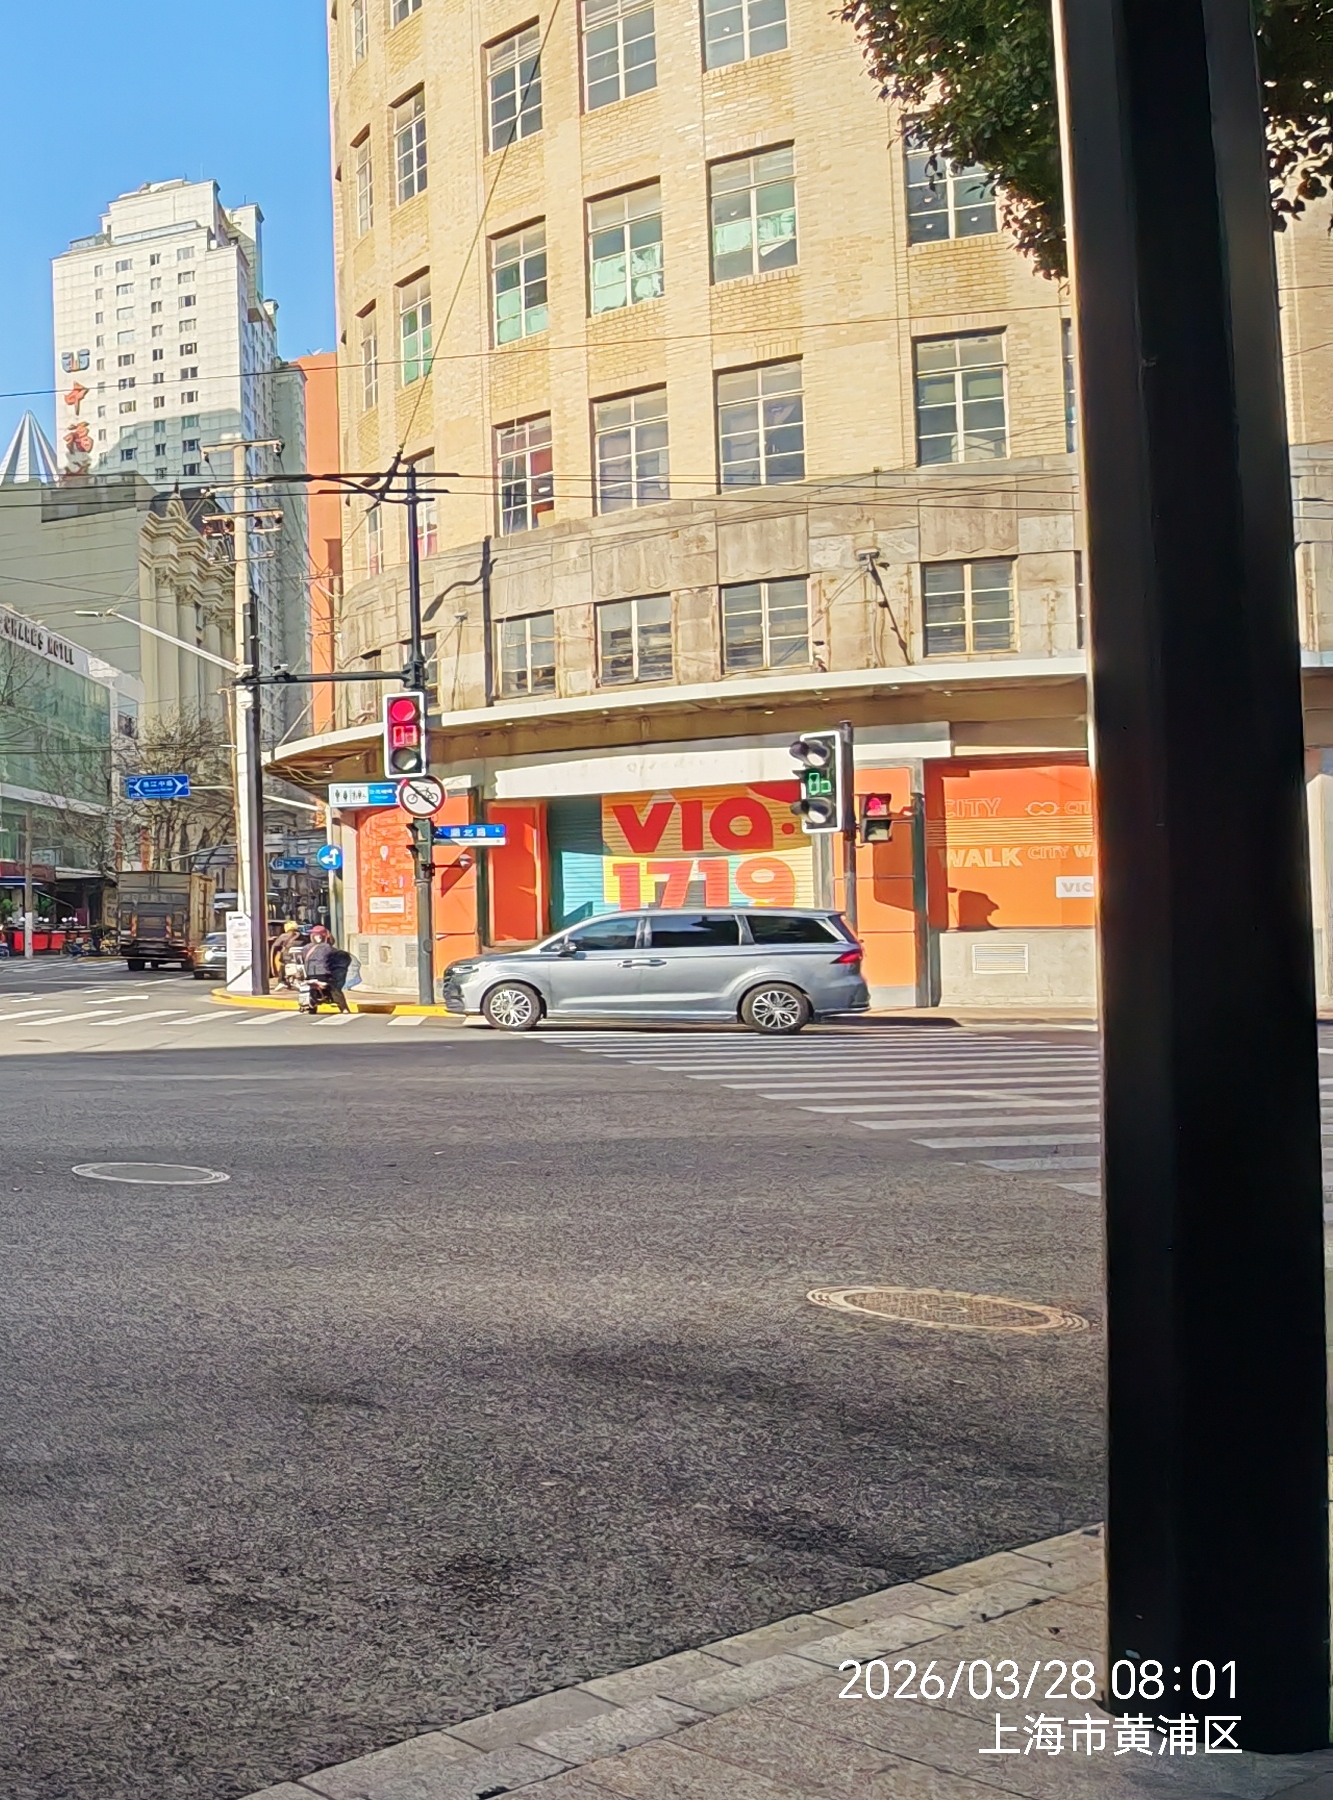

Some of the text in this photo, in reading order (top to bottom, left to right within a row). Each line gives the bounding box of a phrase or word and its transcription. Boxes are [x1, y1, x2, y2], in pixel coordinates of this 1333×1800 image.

[938, 848, 1023, 867] WALK
[1028, 845, 1070, 859] CITY
[613, 857, 797, 910] 1719
